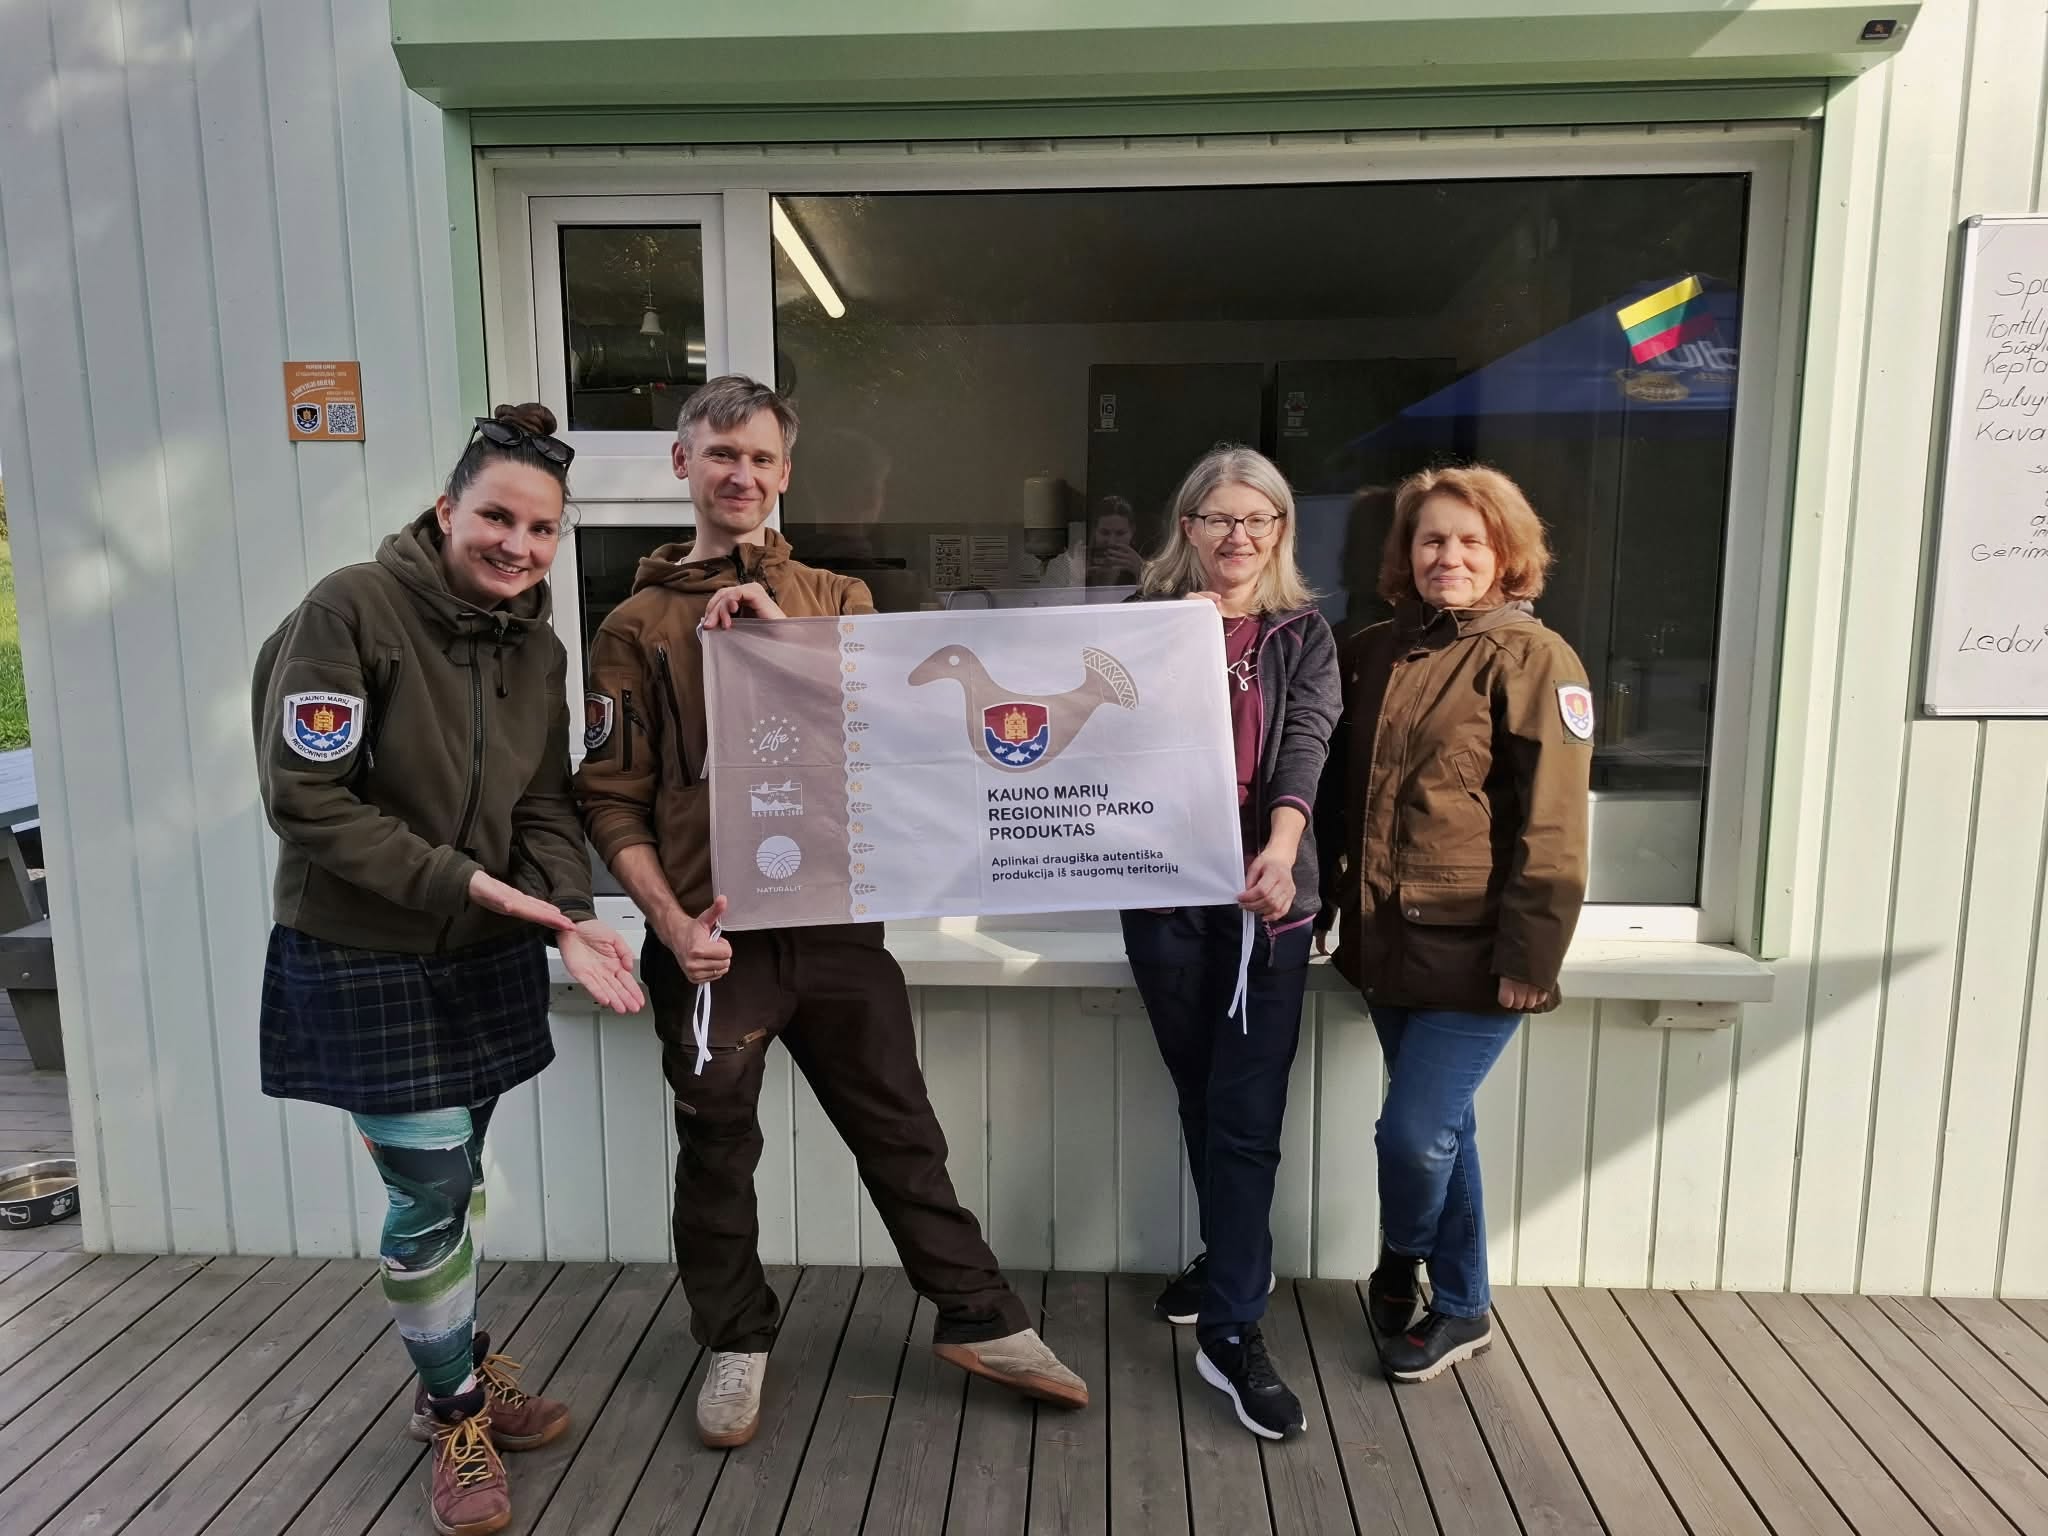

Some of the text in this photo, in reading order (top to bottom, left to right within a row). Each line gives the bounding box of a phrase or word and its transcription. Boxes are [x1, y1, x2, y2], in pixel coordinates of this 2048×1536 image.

[1975, 421, 2046, 441] Kava
[300, 695, 325, 703] KAUNO
[291, 738, 353, 759] REGIONINIS PARKAS
[759, 726, 789, 752] Life
[987, 784, 1109, 803] KAUNO MARIŲ
[988, 801, 1154, 822] REGIONINIO PARKO
[989, 823, 1095, 841] PRODUKTAS
[992, 849, 1163, 869] Aplinkai draugiška autentiška
[992, 862, 1179, 882] produkcija iš saugomų teritorijų
[756, 885, 802, 894] NATURALIT
